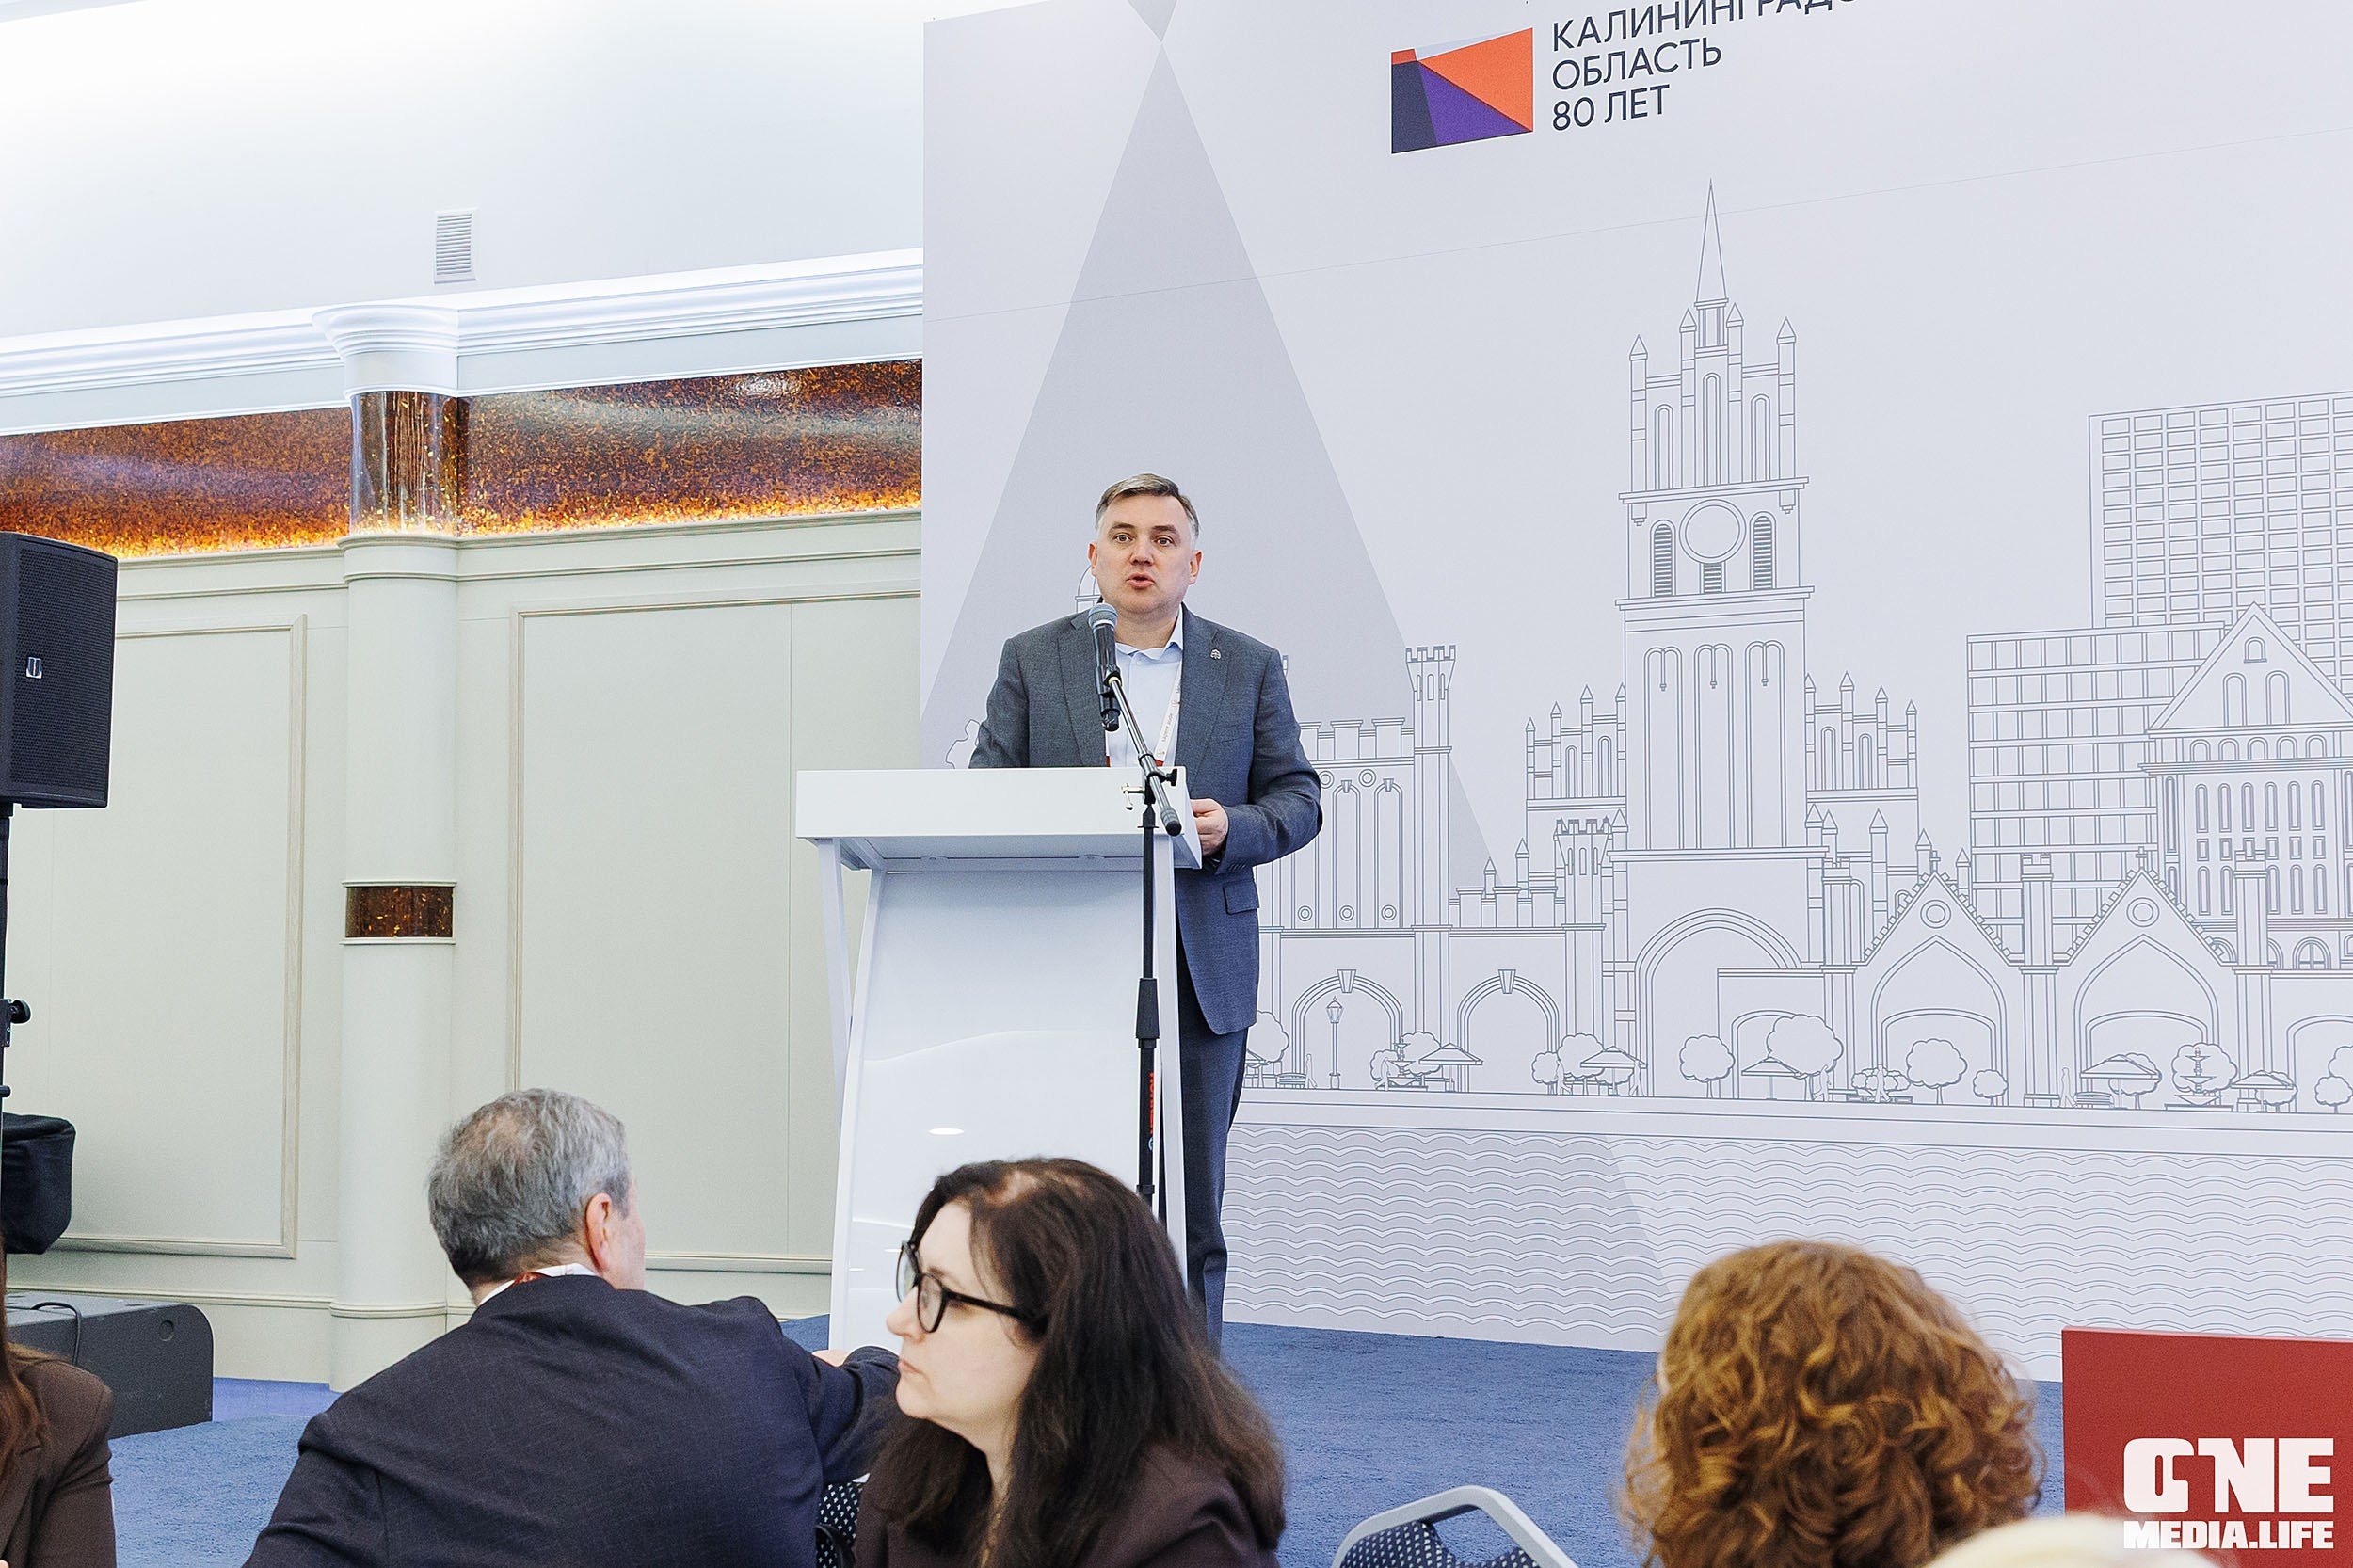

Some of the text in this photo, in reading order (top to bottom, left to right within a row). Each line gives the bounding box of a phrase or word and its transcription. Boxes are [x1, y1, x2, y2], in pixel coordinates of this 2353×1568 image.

[1553, 0, 1856, 52] КАЛИНИН
[1552, 37, 1721, 90] ОБЛАСТЬ
[1552, 84, 1671, 131] 80 ЛЕТ
